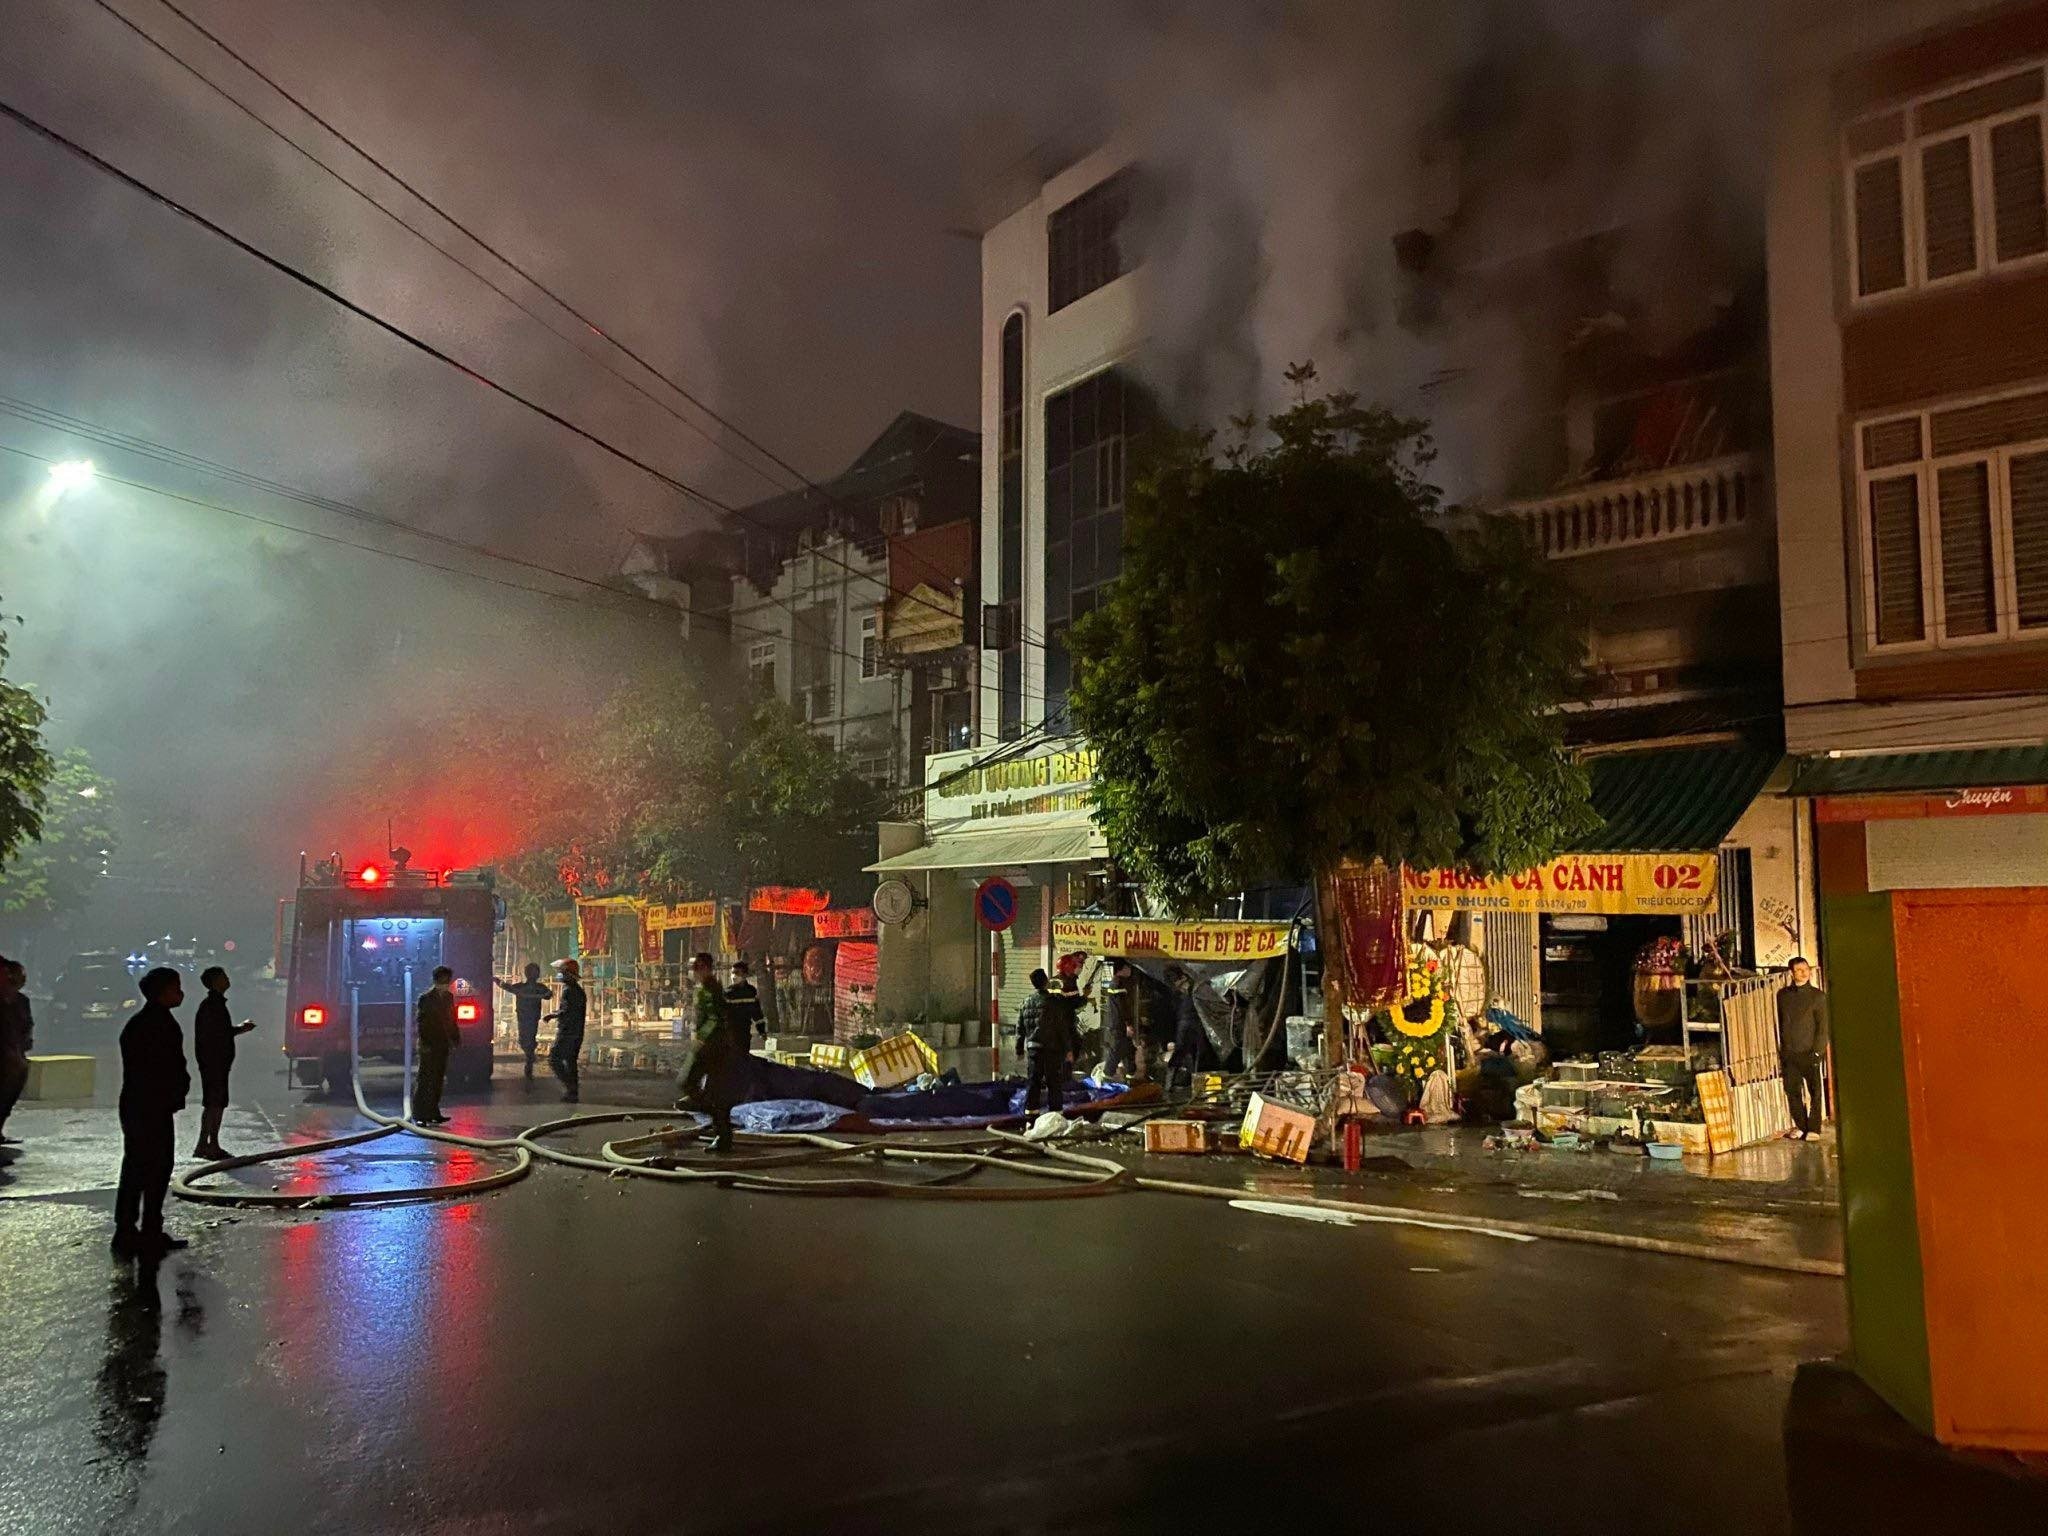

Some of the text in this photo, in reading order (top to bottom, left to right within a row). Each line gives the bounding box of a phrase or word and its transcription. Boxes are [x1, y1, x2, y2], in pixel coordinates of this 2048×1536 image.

[1553, 857, 1624, 891] CẢNH
[1653, 864, 1702, 889] 02
[1410, 895, 1450, 907] LONG
[1456, 895, 1510, 908] NHUNG
[1054, 921, 1097, 937] HOÀNG
[1103, 925, 1119, 949] CÁ
[1124, 924, 1159, 950] CẢNH
[1173, 926, 1210, 952] THIẾT
[1215, 931, 1229, 956] BỊ
[1233, 926, 1253, 953] BỂ
[1257, 928, 1276, 952] CÁ
